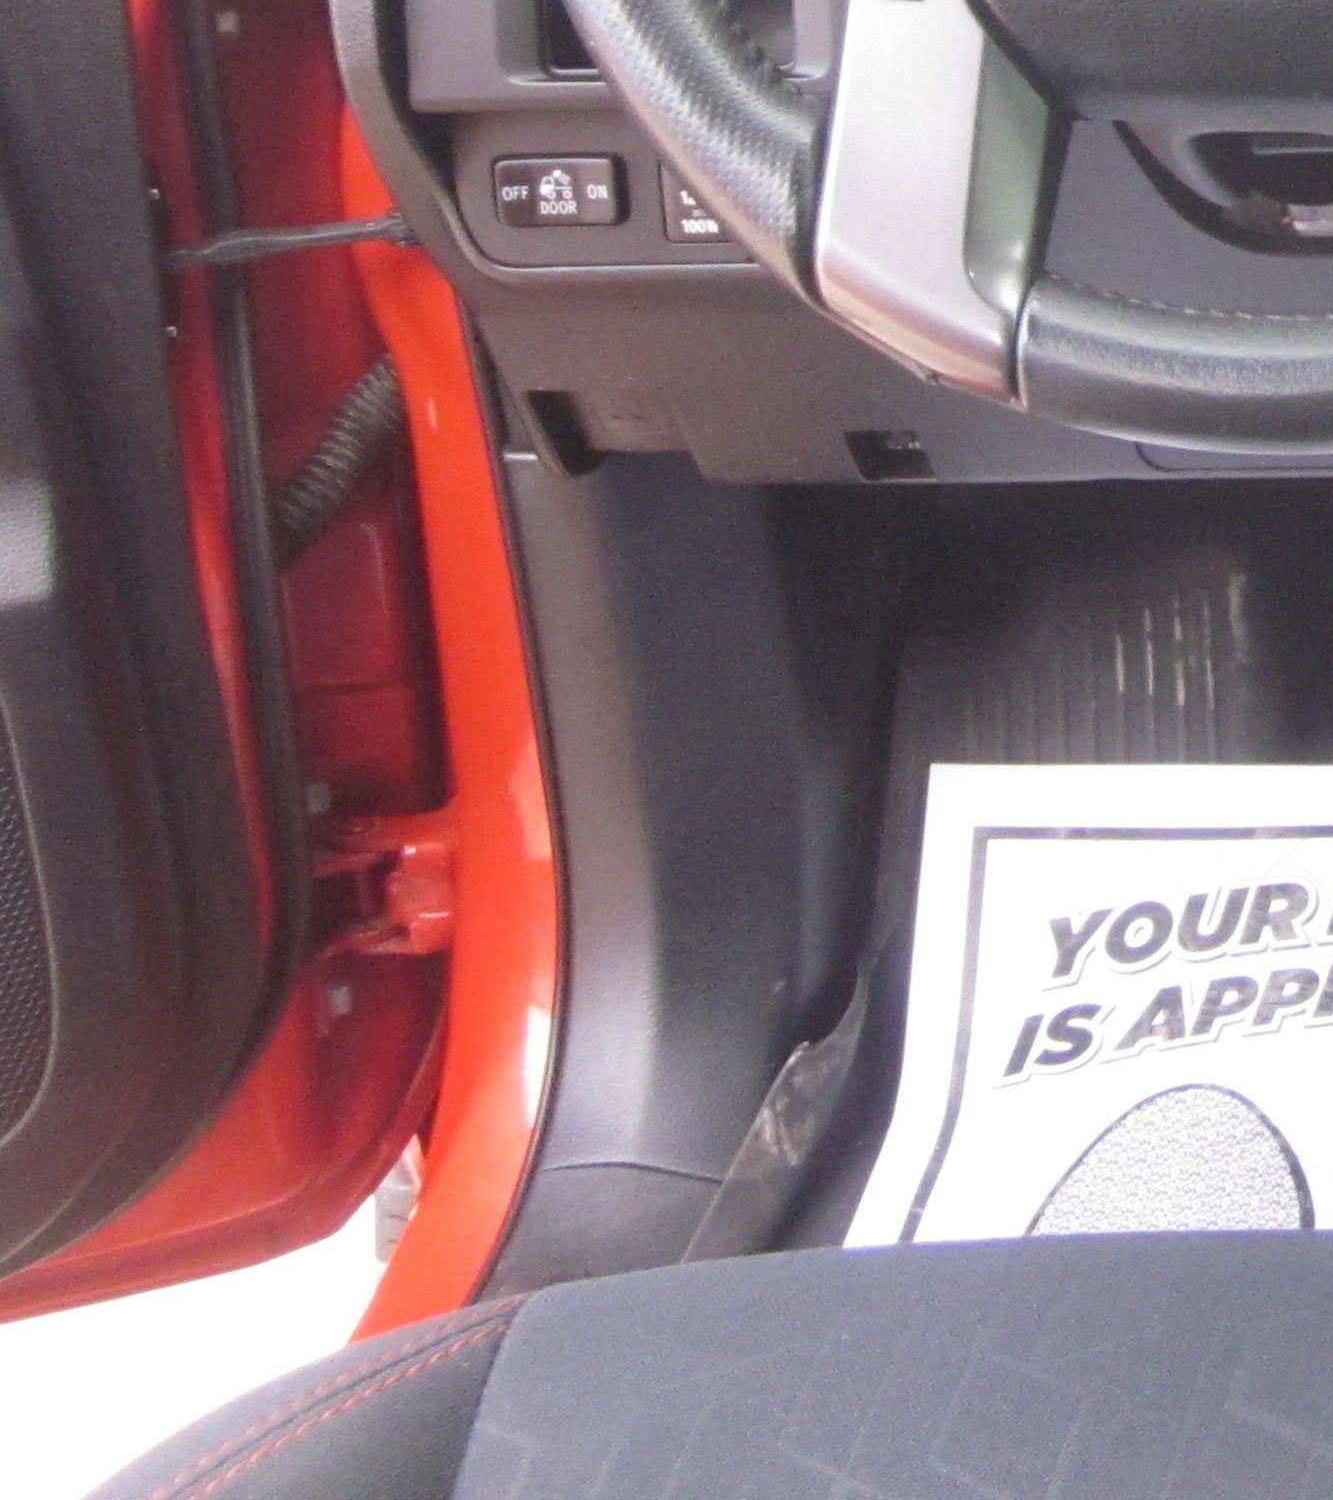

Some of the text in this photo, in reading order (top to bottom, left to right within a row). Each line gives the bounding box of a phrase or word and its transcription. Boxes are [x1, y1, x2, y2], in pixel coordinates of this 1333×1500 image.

[502, 185, 529, 201] OFF
[587, 185, 608, 199] ON
[540, 201, 577, 215] DOOR
[1047, 881, 1312, 980] YOUR
[1001, 1002, 1104, 1079] IS
